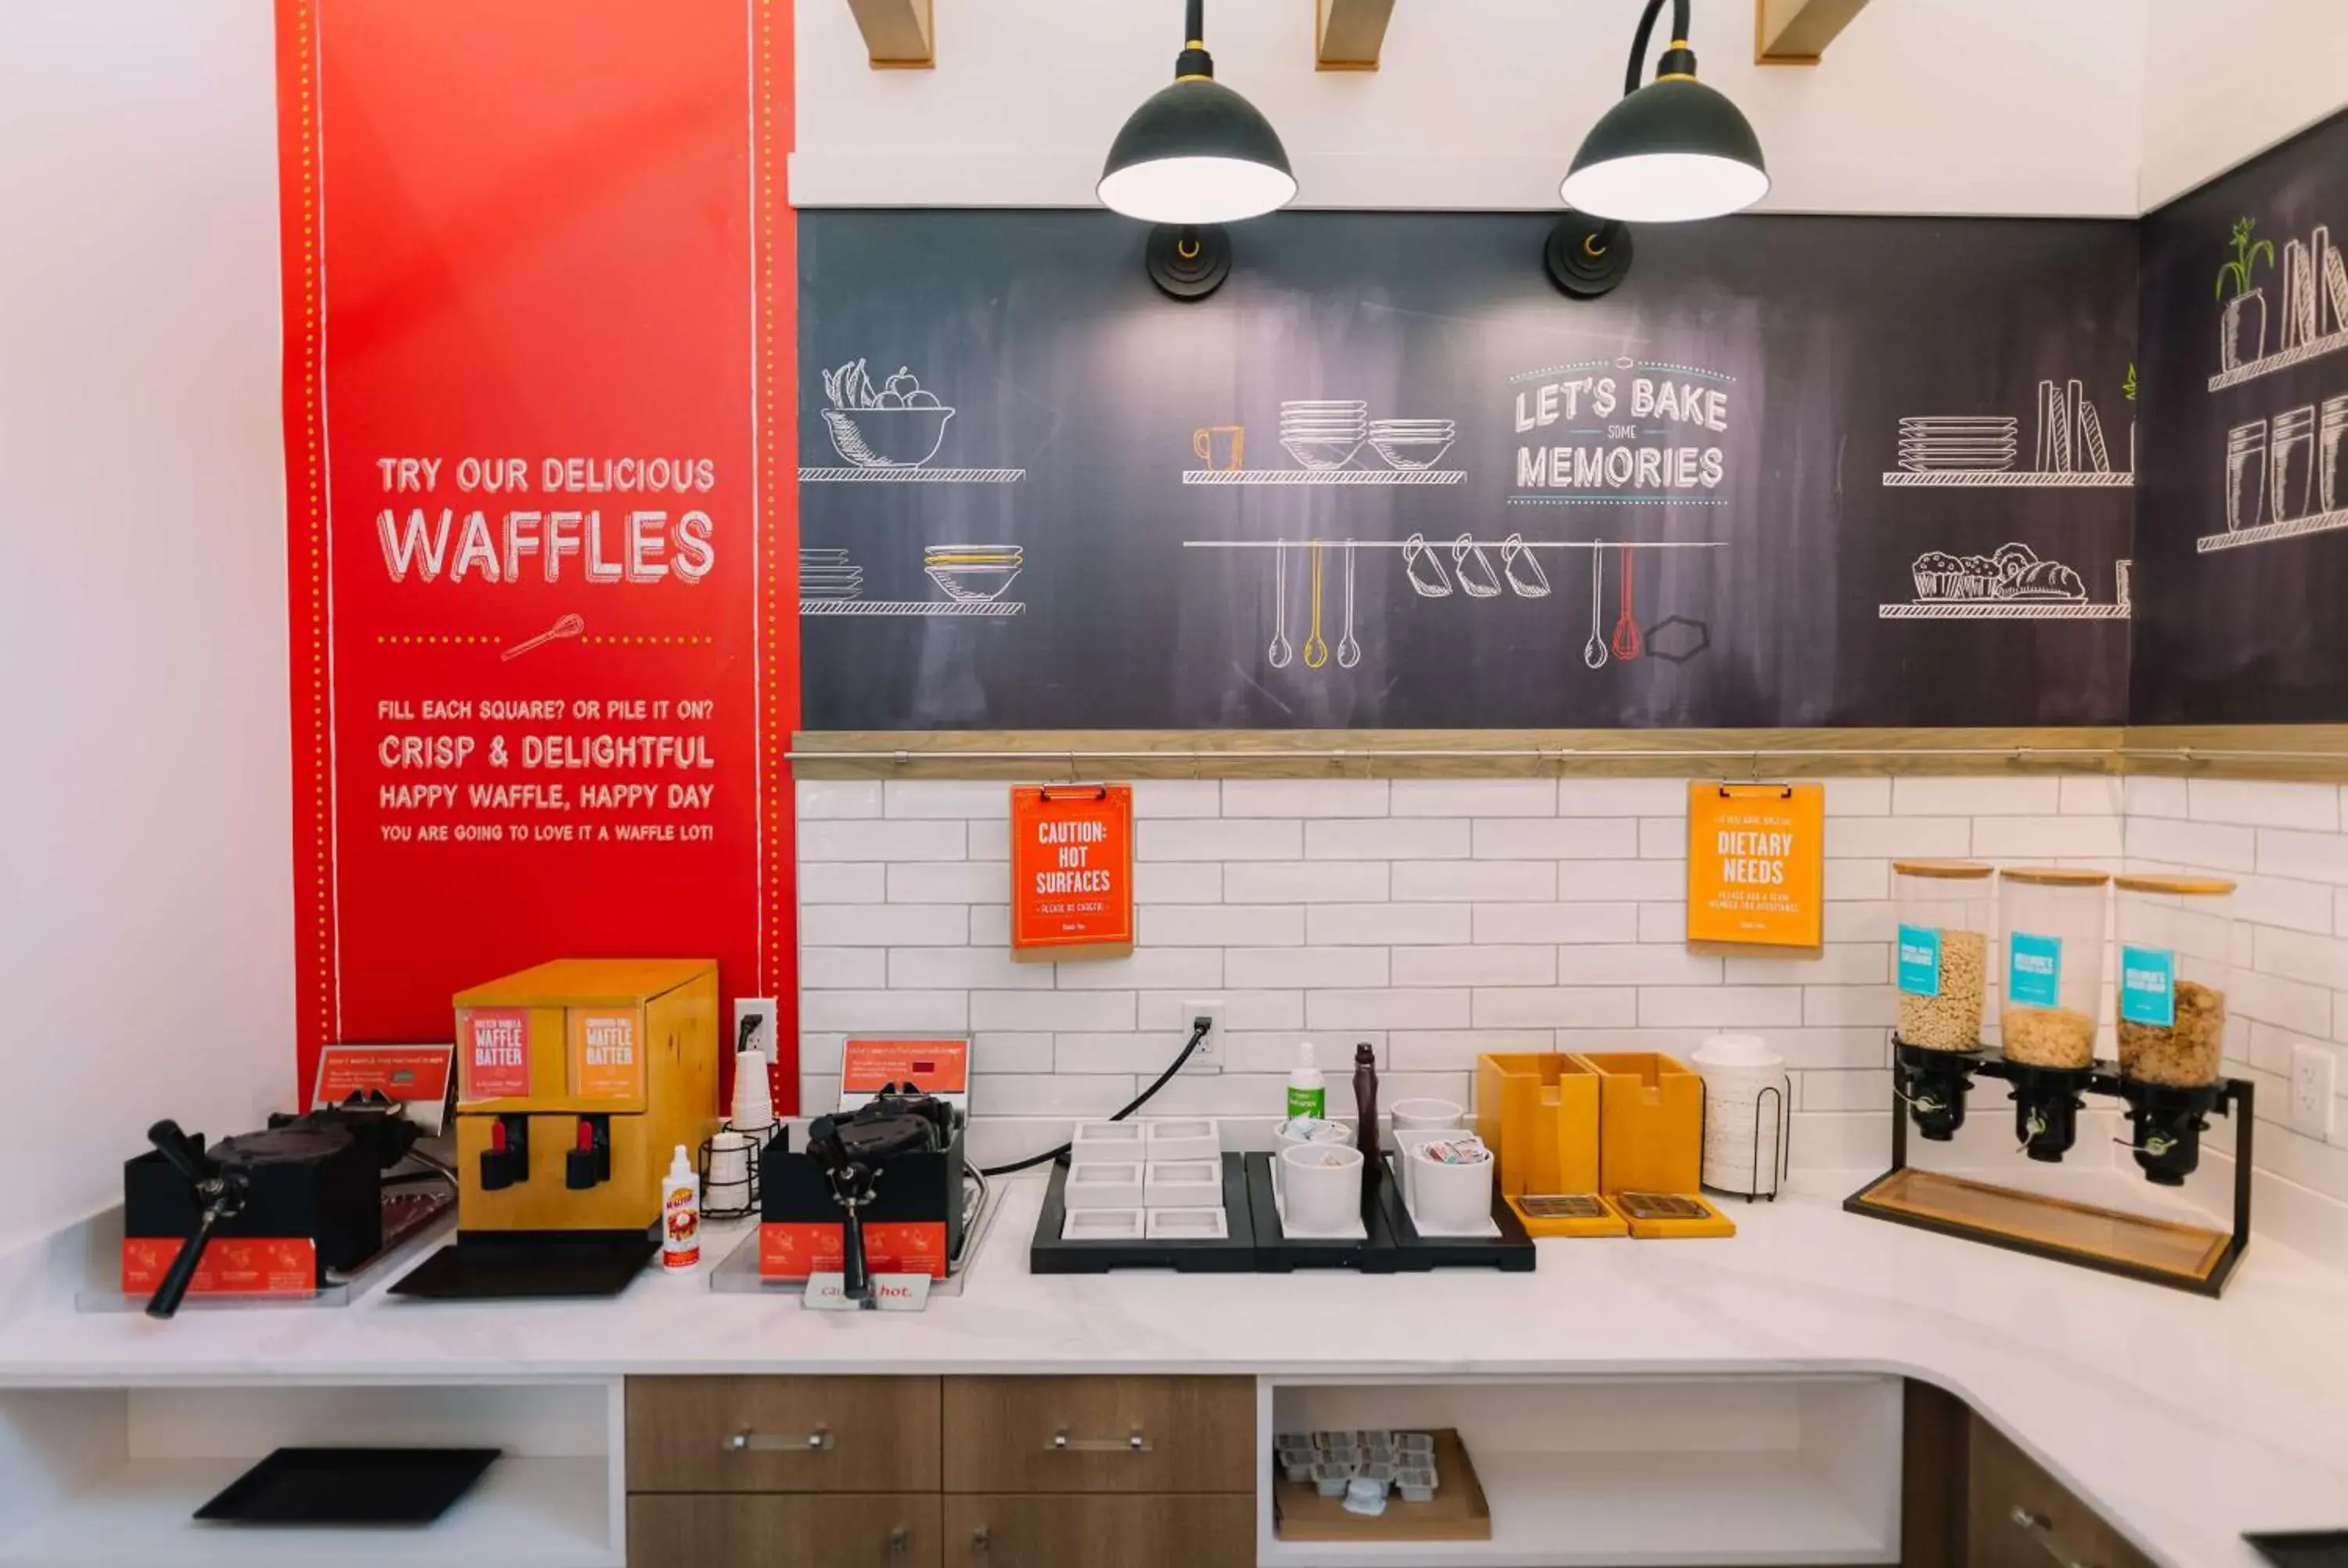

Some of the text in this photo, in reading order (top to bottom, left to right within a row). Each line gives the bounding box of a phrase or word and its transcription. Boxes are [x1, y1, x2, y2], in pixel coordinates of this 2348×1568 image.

[1515, 377, 1728, 433] LET'S BAKE
[1608, 425, 1637, 440] SOME
[377, 457, 715, 494] TRY OUR DELICIOUS
[1517, 447, 1723, 489] MEMORIES
[376, 508, 715, 584] WAFFLES
[378, 699, 714, 720] FILL EACH SQUARE? OR PILE IT ON?
[379, 734, 715, 769] CRISP & DELIGHTFUL
[380, 784, 715, 811] HAPPY WAFFLE, HAPPY DAY
[380, 825, 714, 841] YOU ARE GOING TO LOVE IT A WAFFLE LOT!
[1038, 821, 1107, 844] CAUTION:
[1717, 830, 1794, 857] DIETARY
[1058, 846, 1089, 869] HOT
[1035, 869, 1111, 894] SURFACES
[1723, 858, 1784, 885] NEEDS
[476, 1028, 523, 1048] WAFFLE
[586, 1027, 632, 1046] WAFFLE
[475, 1048, 522, 1066] BATTER
